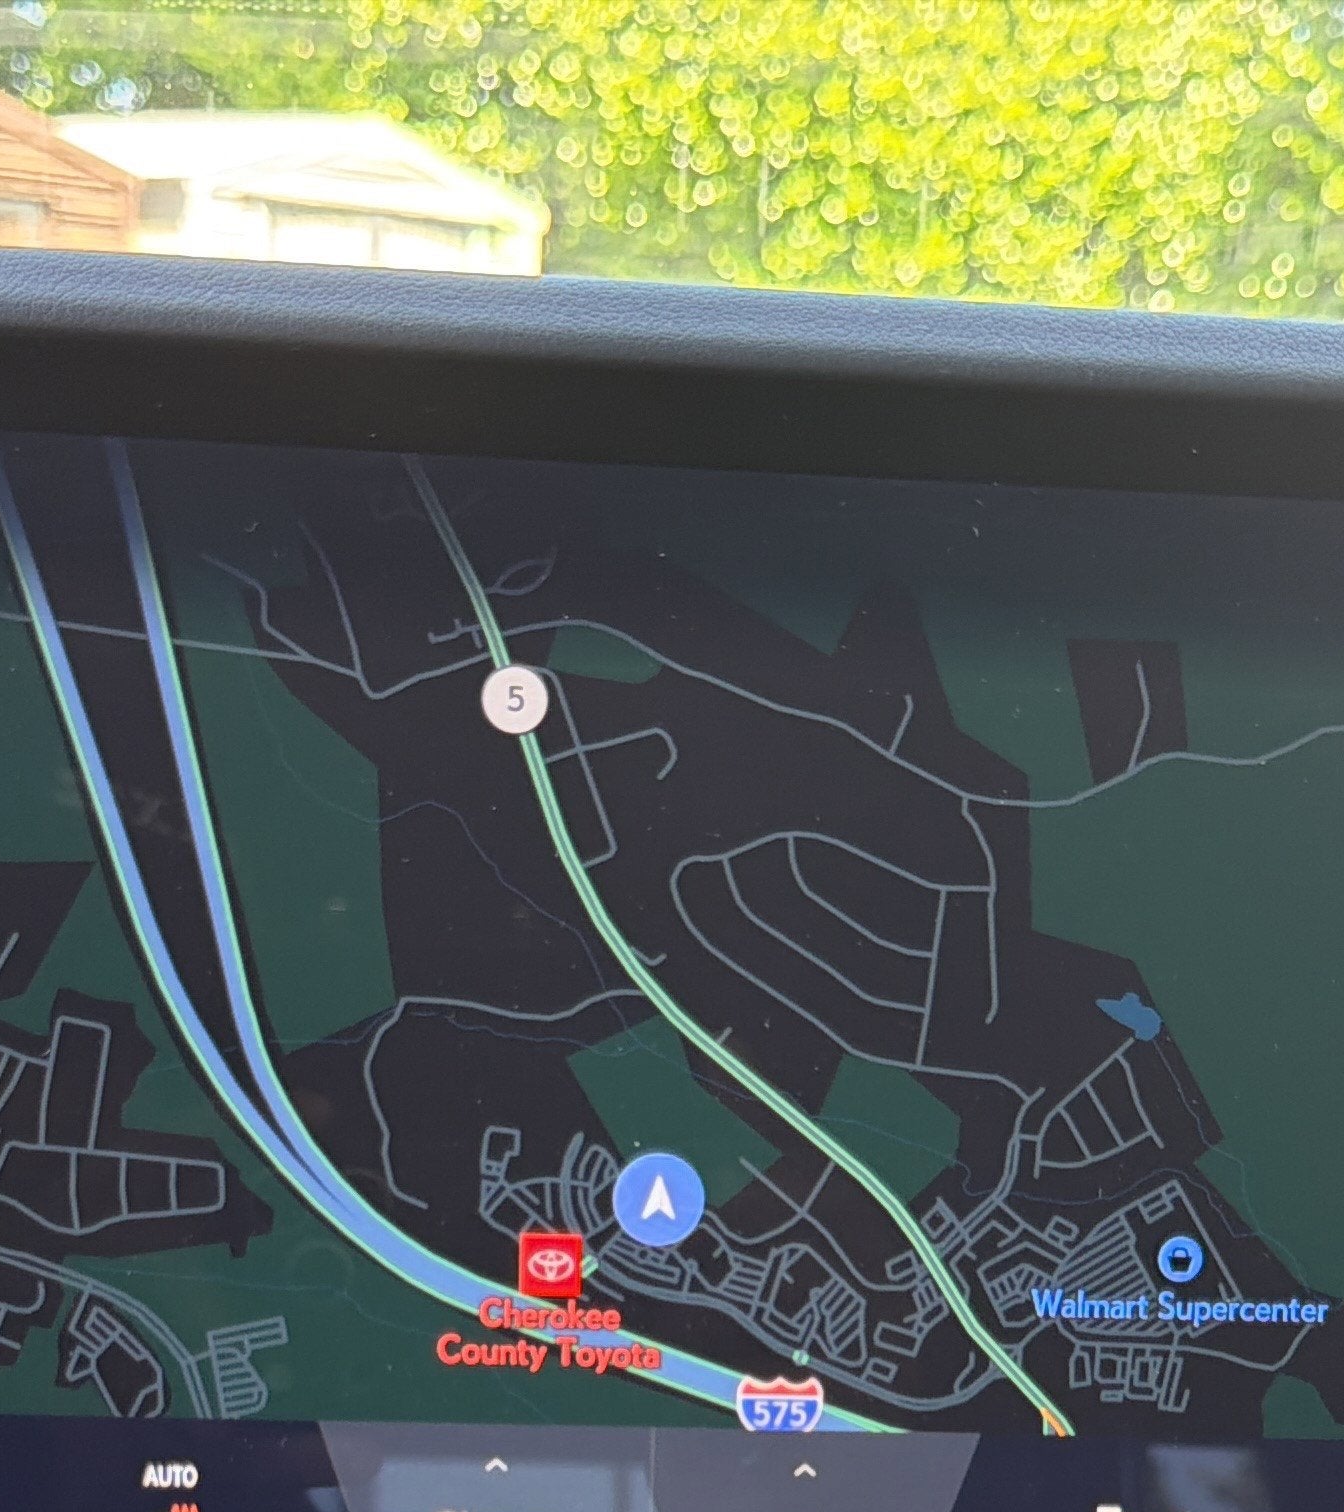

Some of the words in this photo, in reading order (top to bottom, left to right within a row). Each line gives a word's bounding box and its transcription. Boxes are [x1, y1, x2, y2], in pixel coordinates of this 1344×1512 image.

[507, 685, 525, 712] 5
[478, 1298, 622, 1330] Cherokee
[1033, 1289, 1149, 1319] Walmart
[1159, 1290, 1329, 1326] Supercenter
[436, 1333, 548, 1373] County
[555, 1337, 662, 1376] Toyota
[754, 1402, 808, 1429] 575
[143, 1464, 198, 1488] AUTO
